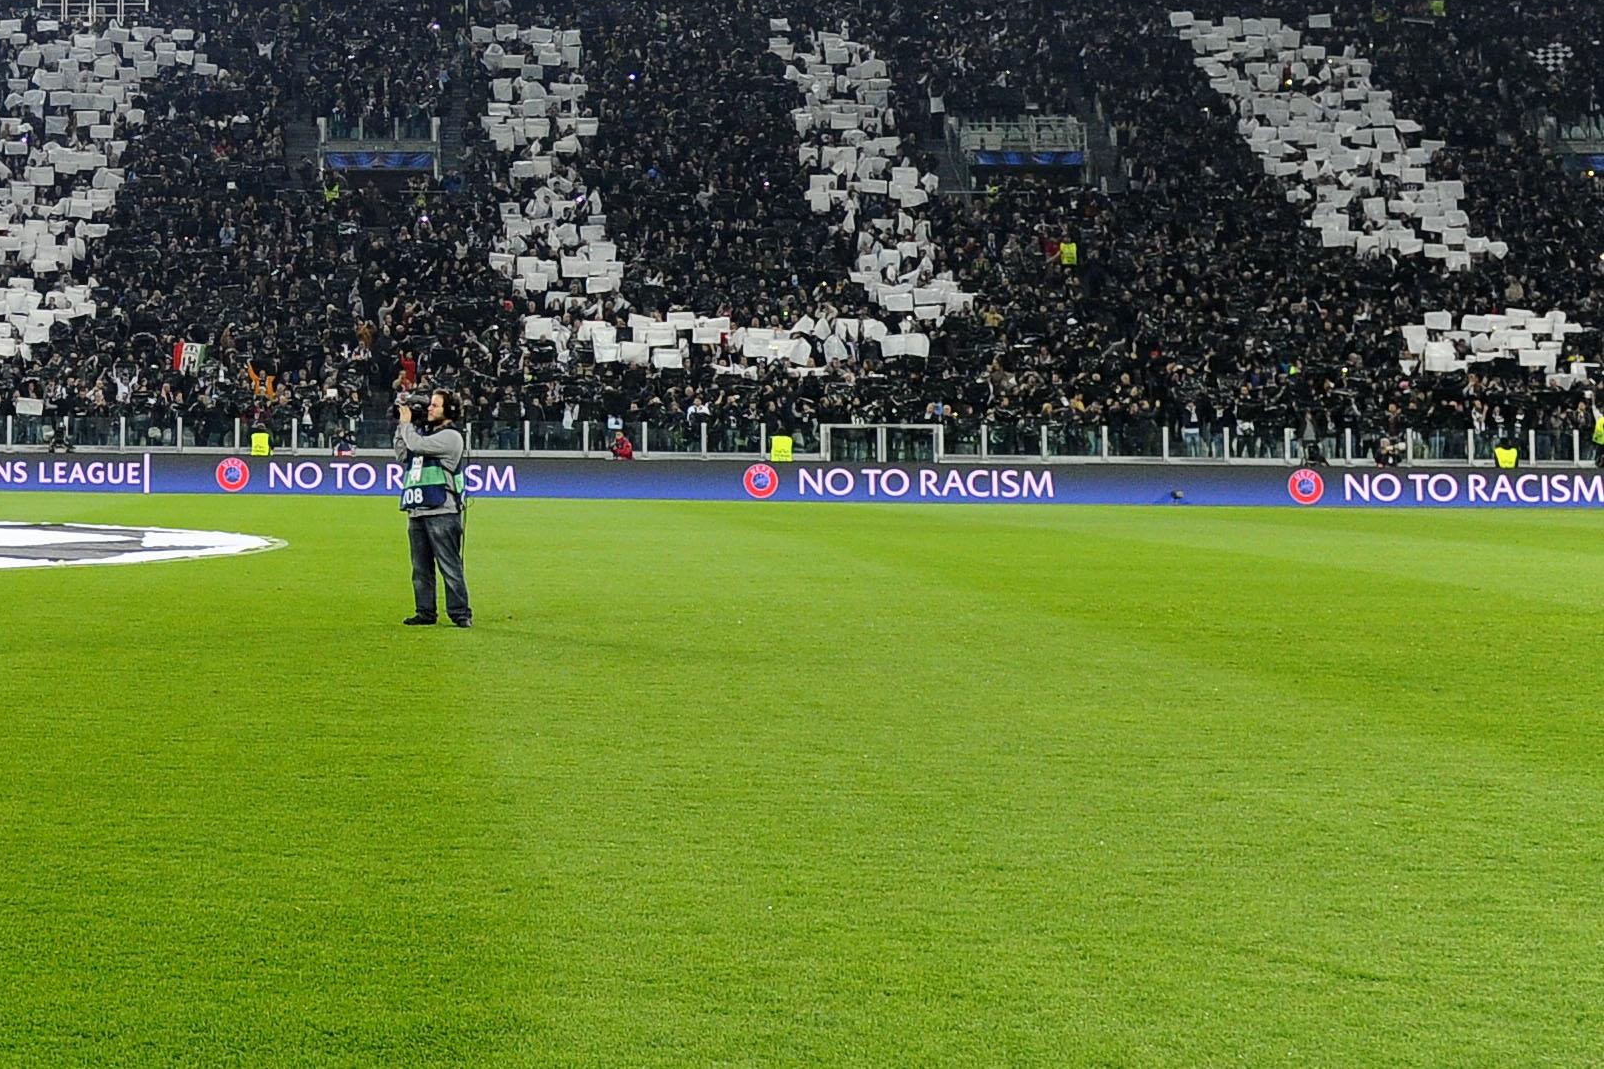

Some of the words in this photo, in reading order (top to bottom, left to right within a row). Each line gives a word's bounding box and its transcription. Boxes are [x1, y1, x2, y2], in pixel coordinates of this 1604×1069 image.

[38, 461, 141, 484] LEAGUE
[269, 462, 323, 489] NO
[329, 462, 376, 490] TO
[386, 463, 516, 492] RSM
[798, 468, 854, 496] NO
[861, 468, 910, 497] TO
[919, 469, 1054, 498] RACISM
[1344, 473, 1402, 502] NO
[1407, 473, 1458, 502] TO
[1468, 474, 1604, 503] RACISM
